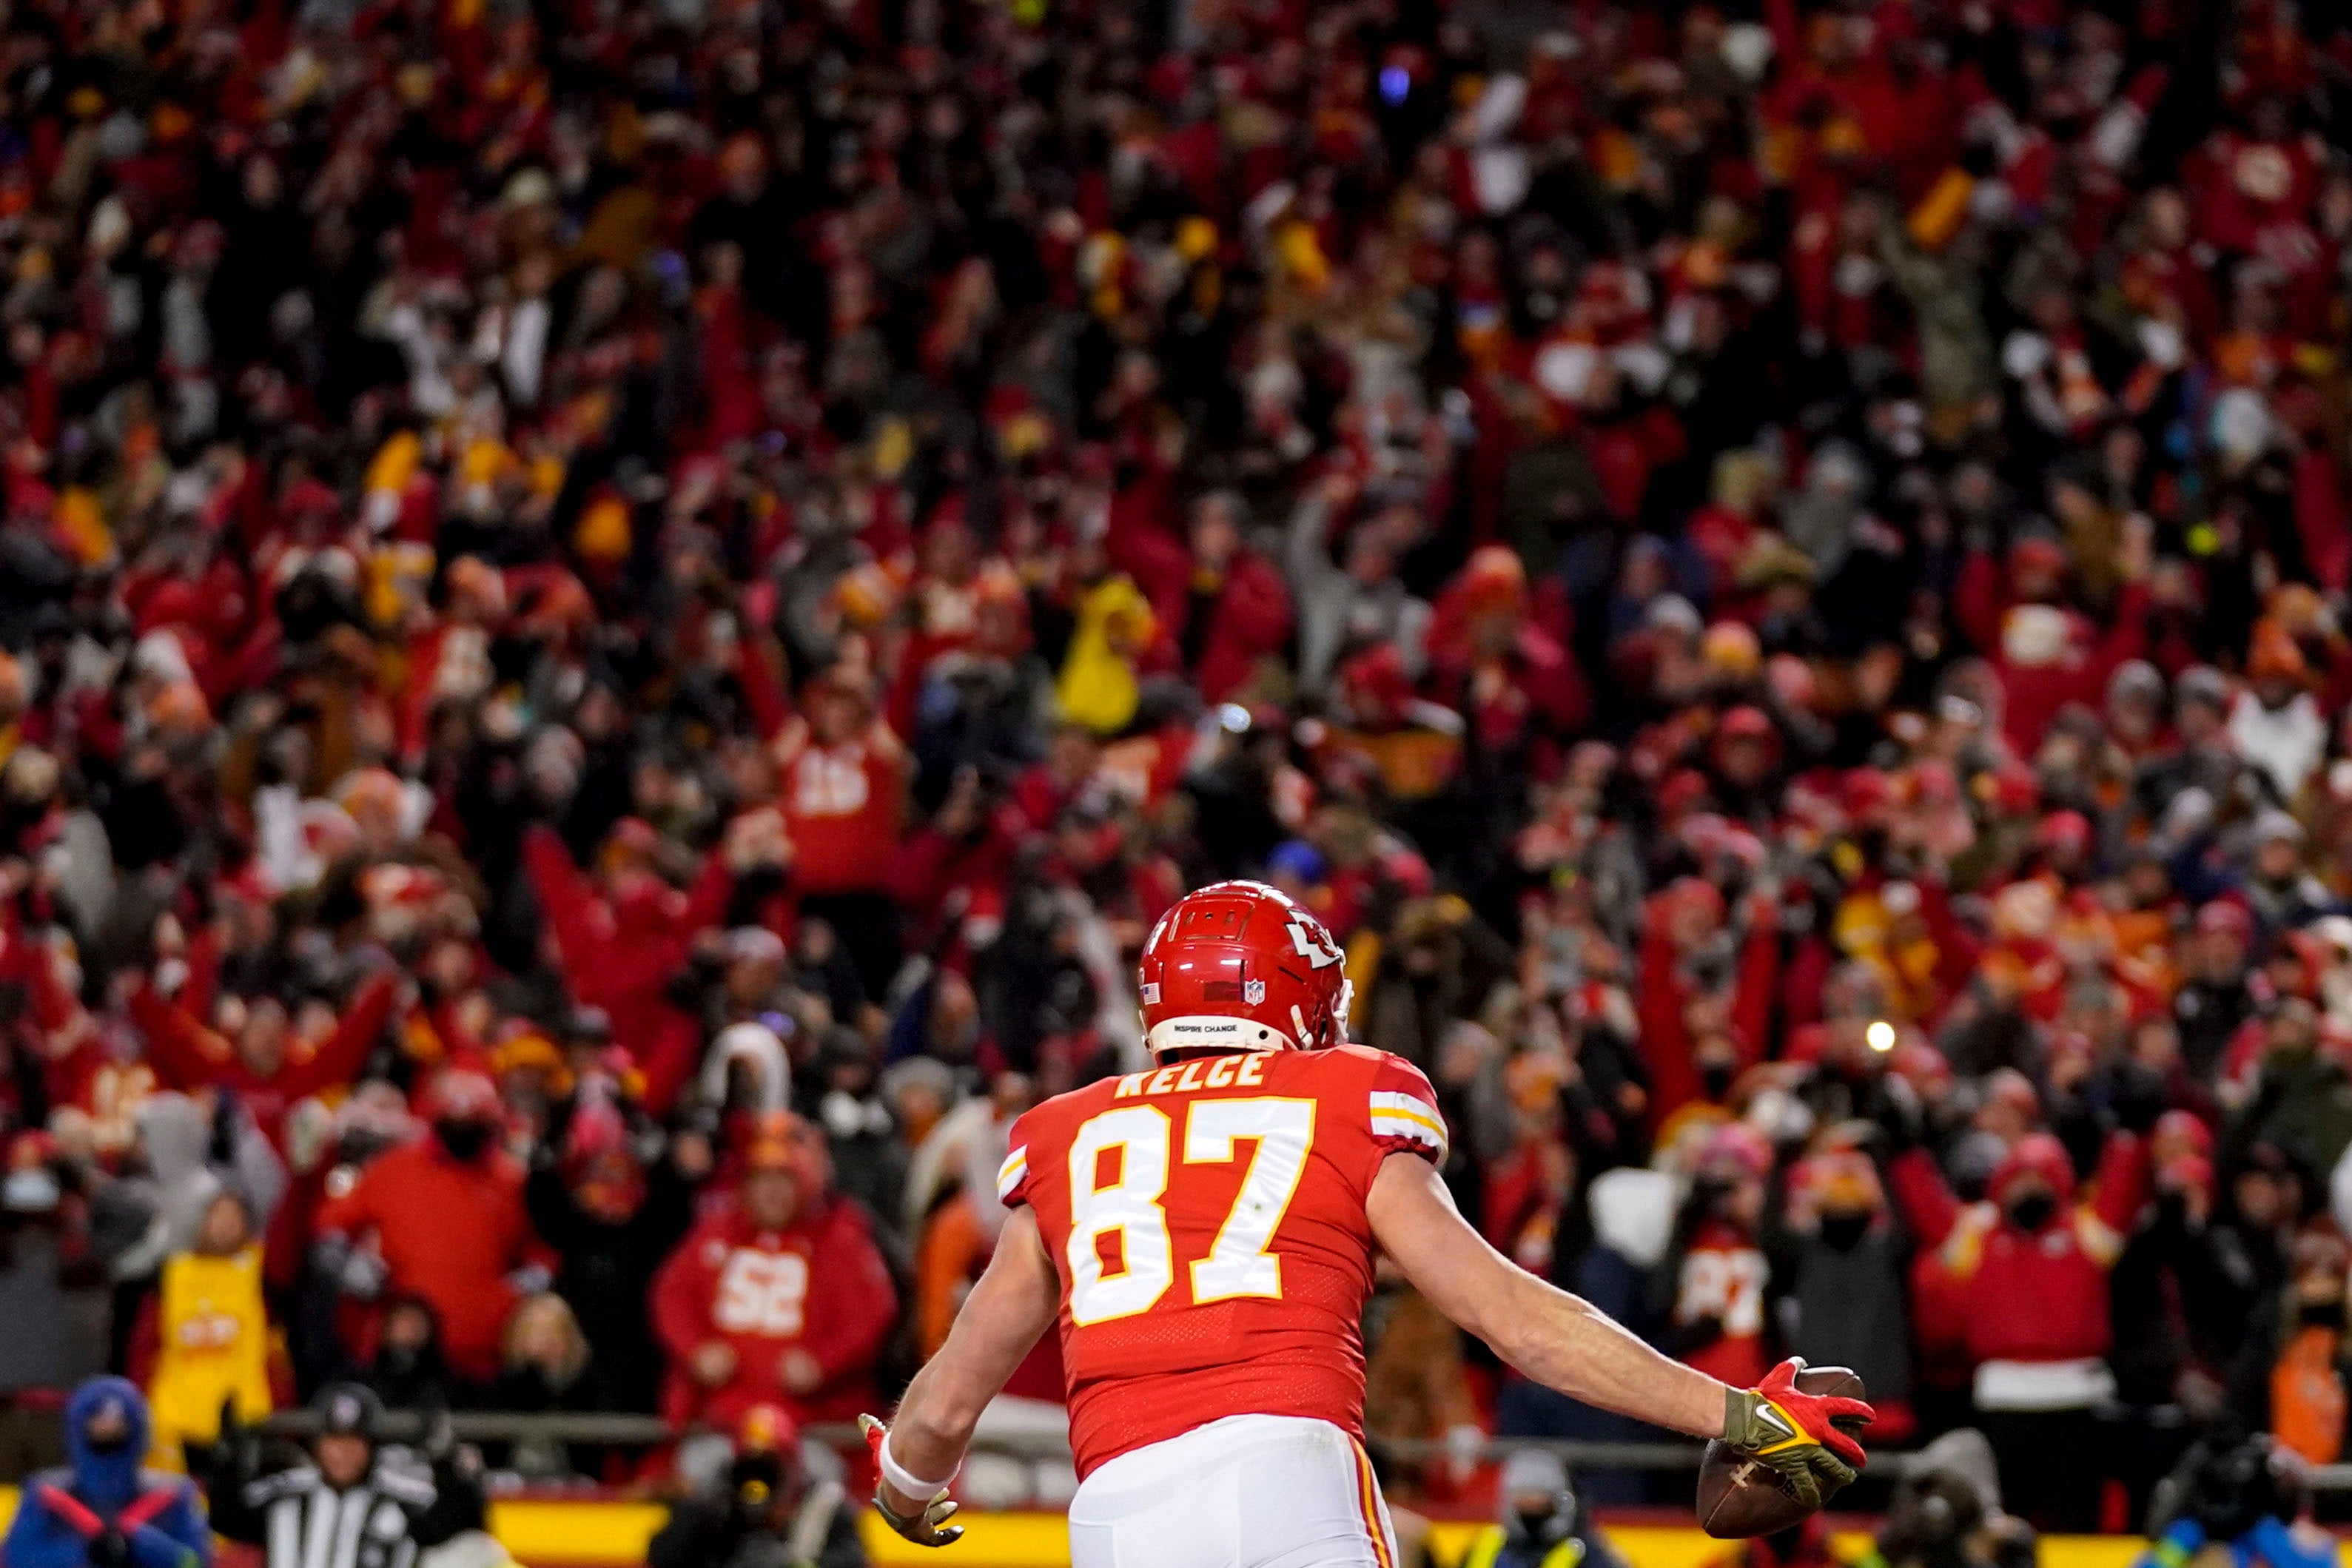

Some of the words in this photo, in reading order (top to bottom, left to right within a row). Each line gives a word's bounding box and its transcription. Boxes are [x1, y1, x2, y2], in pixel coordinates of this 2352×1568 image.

[1174, 1025, 1202, 1033] INSPIRE
[1204, 1024, 1237, 1033] CHANGE
[1114, 1050, 1276, 1100] KELCE
[1066, 1095, 1317, 1328] 87
[714, 1247, 807, 1336] 52
